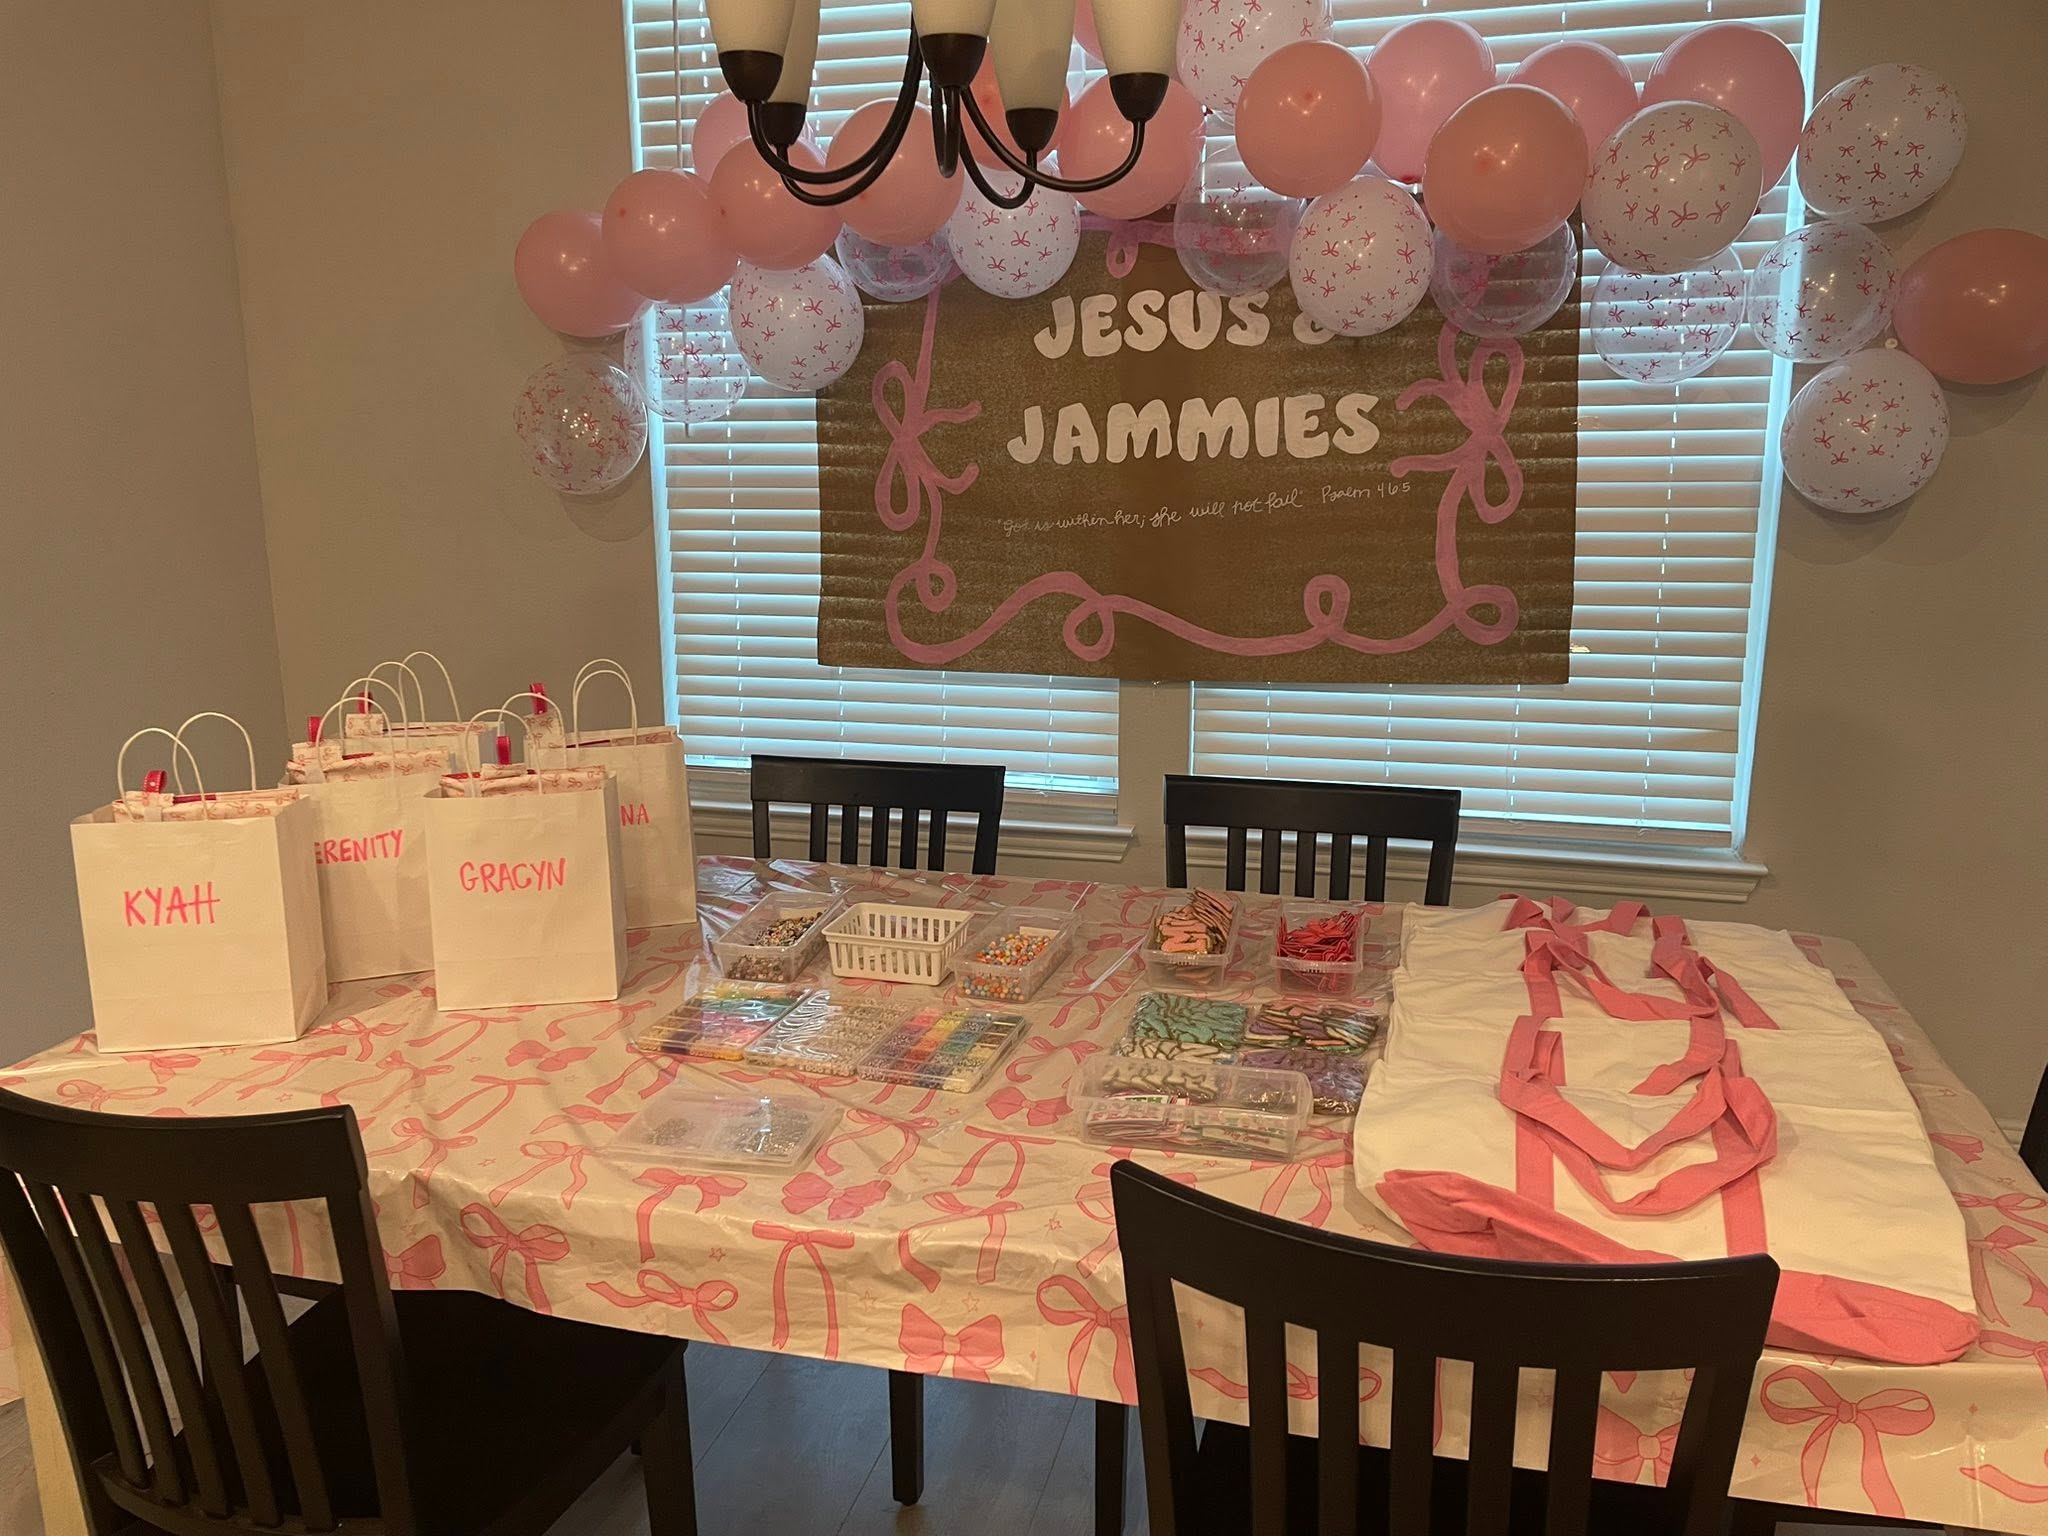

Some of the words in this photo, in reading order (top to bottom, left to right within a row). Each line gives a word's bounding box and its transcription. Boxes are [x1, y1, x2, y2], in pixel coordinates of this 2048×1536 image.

[1033, 289, 1270, 359] JESUS
[1006, 393, 1380, 465] JAMMIES
[1056, 513, 1114, 529] within
[1150, 507, 1182, 528] she
[1189, 502, 1225, 518] will
[1232, 497, 1263, 515] not
[1321, 484, 1370, 503] Psalm
[459, 857, 567, 894] GRACYN
[123, 881, 221, 927] KYAH
